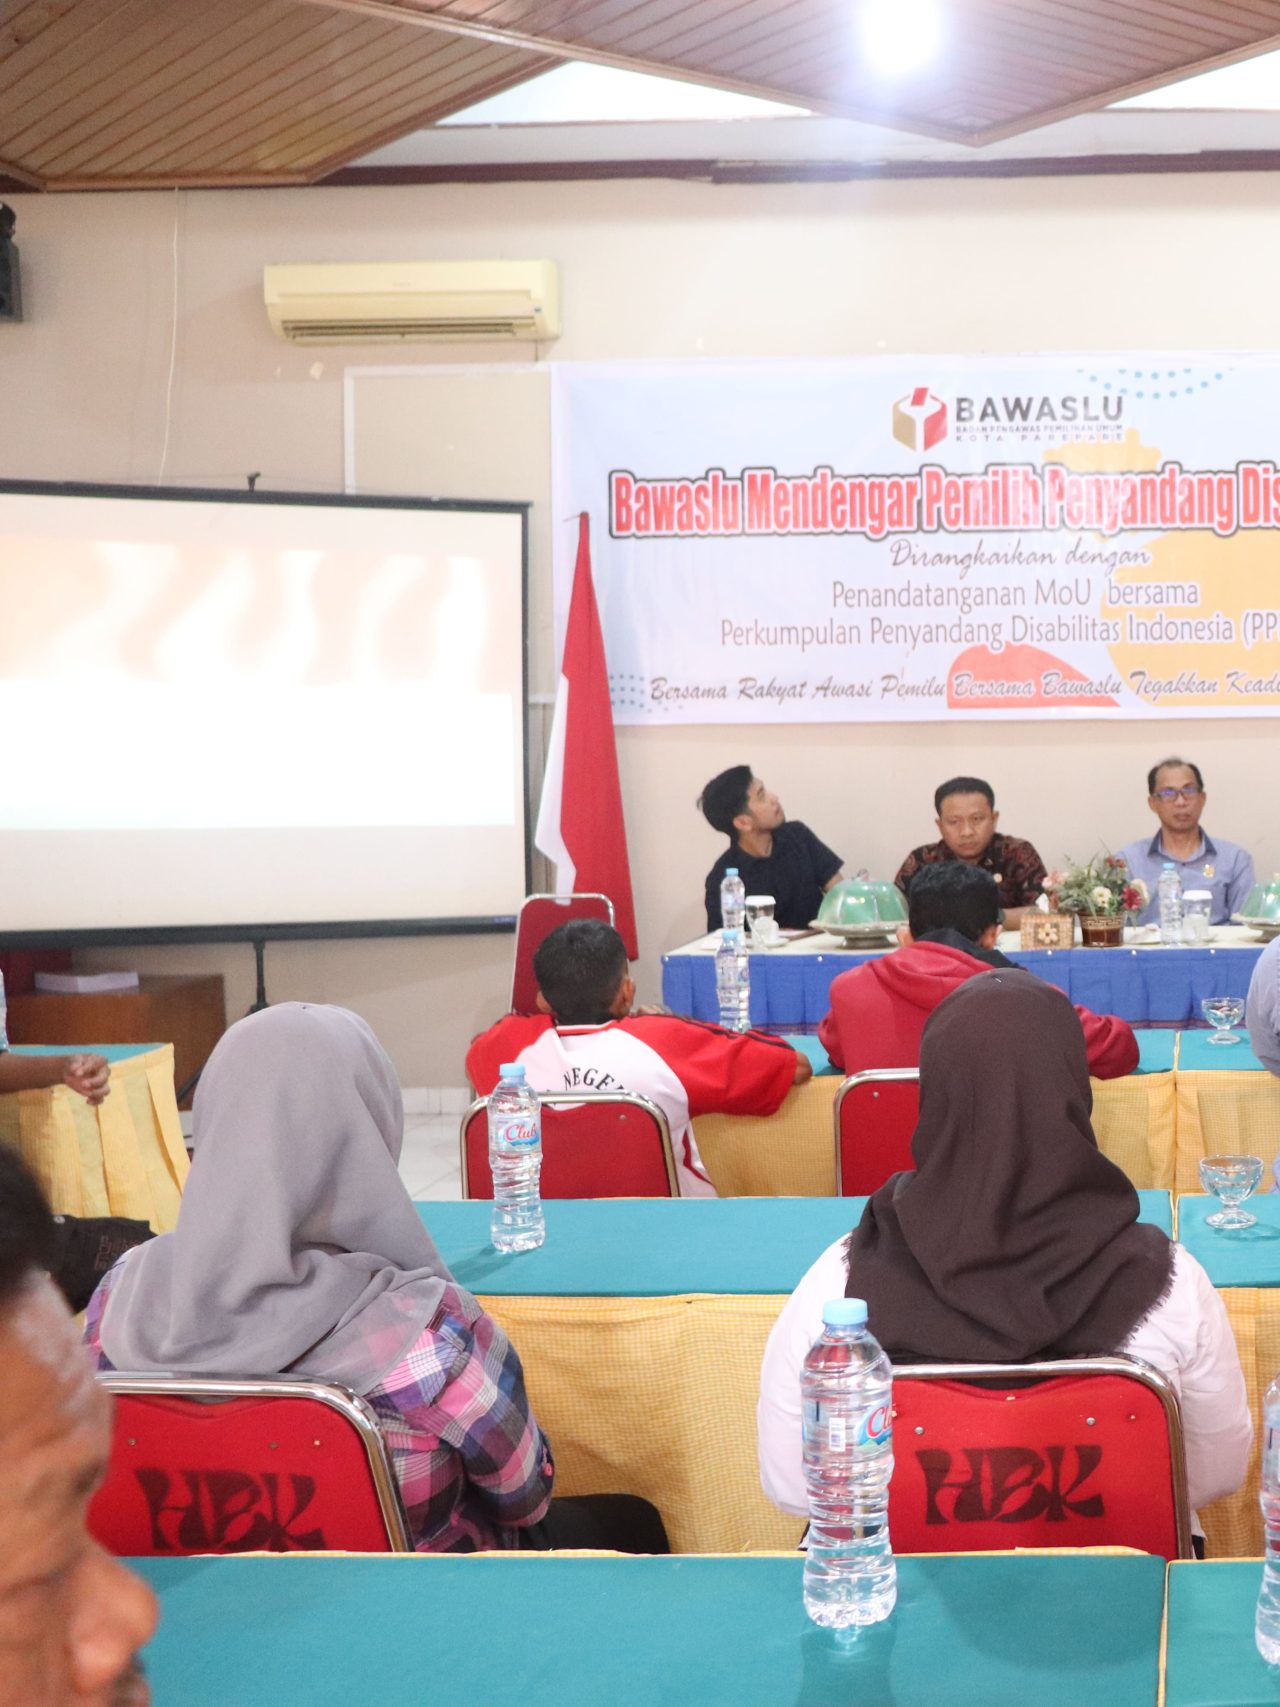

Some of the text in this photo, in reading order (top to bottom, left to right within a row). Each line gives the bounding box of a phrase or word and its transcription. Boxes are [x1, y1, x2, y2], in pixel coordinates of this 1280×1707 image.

[956, 396, 1123, 422] BAWASLU
[956, 434, 1004, 442] KOTA
[613, 472, 741, 533] Bawaslu
[747, 471, 918, 536] Mendengar
[924, 469, 1040, 528] Pemilih
[1047, 467, 1235, 532] Penyandang
[890, 536, 1151, 580] Dirangkaikan dengan
[832, 578, 1199, 615] Penandatanganan MoU bersama
[721, 618, 861, 652] Perkumpulan
[870, 616, 1003, 651] Penyandang
[1012, 615, 1120, 643] Disabilitas
[1129, 613, 1234, 642] Indonesia
[650, 677, 728, 700] Bersama
[737, 676, 807, 705] Rakyat
[811, 674, 873, 699] Awasi
[880, 673, 945, 700] Pemilu
[954, 672, 1034, 697] Bersama
[1041, 671, 1122, 696] Bawaslu
[1129, 670, 1219, 701] Tegakkan
[914, 1444, 1105, 1526] HBK
[134, 1467, 328, 1552] HBK
